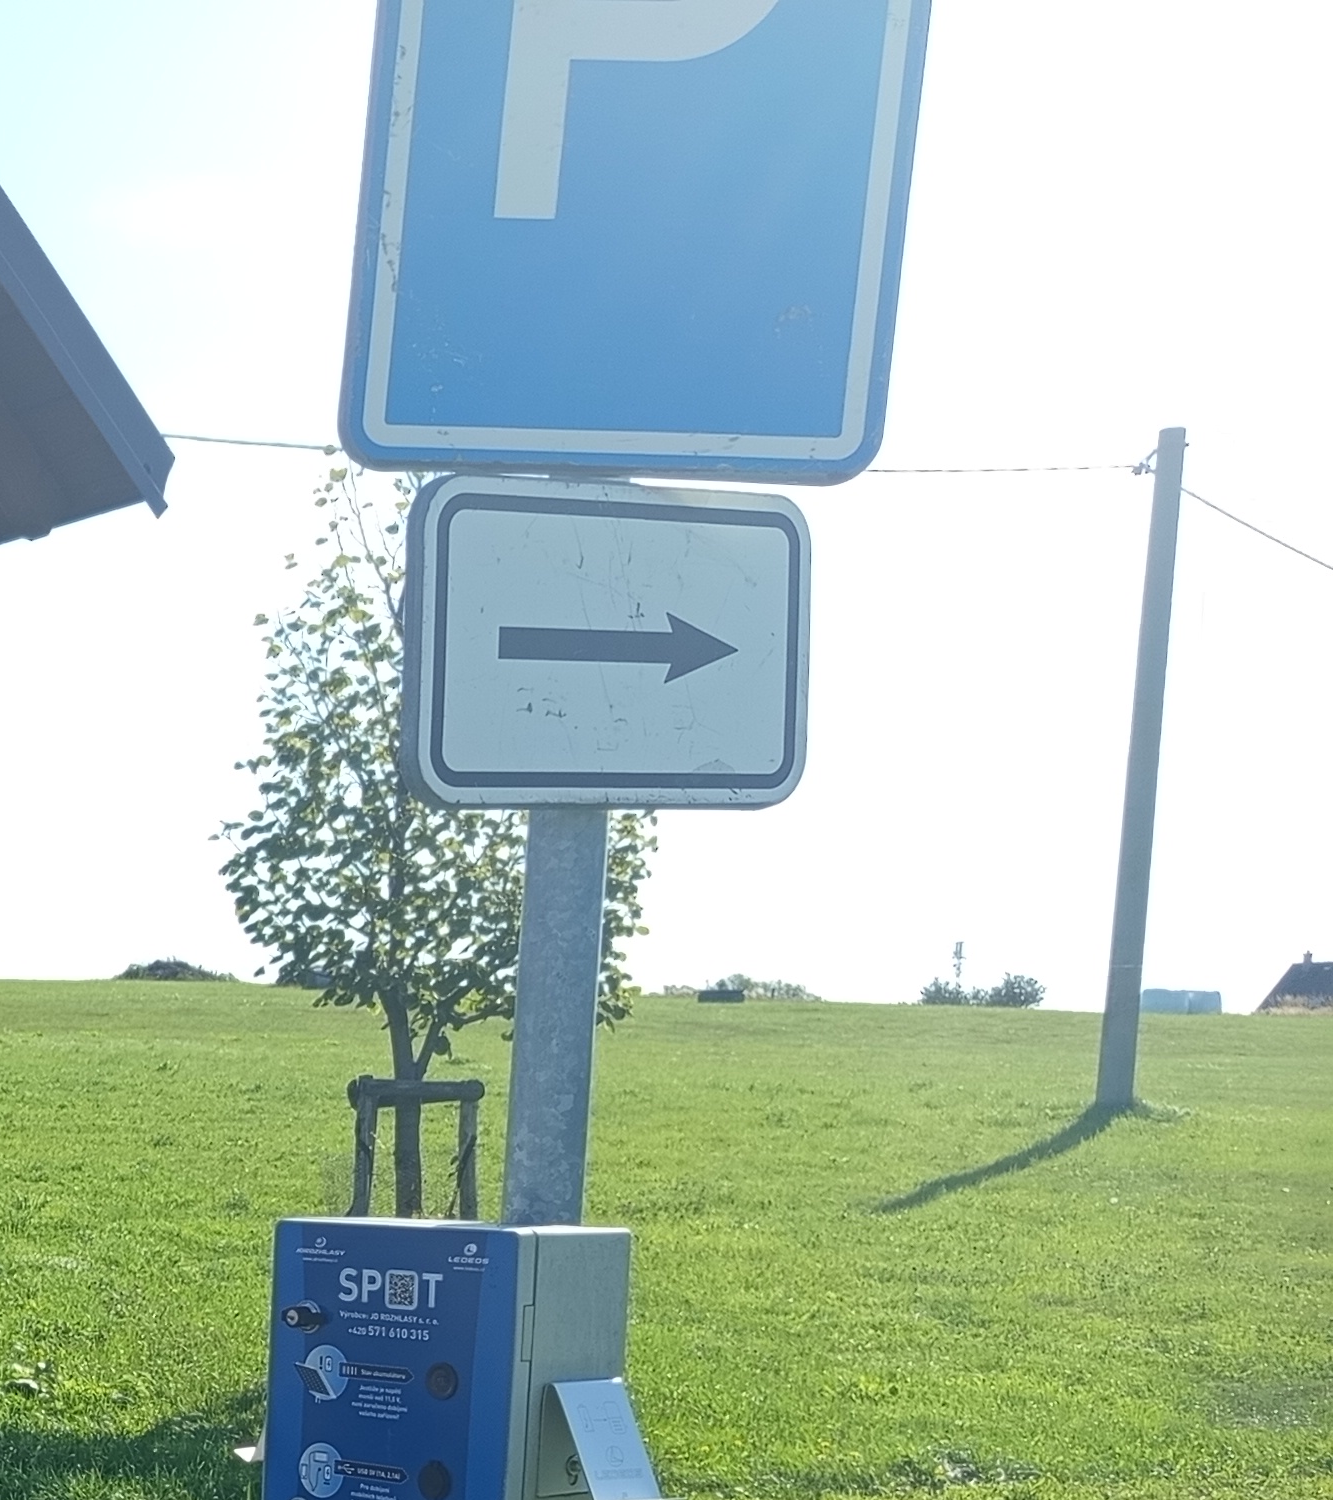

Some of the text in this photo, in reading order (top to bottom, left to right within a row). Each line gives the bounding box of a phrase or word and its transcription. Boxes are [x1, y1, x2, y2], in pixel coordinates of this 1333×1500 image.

[448, 1256, 489, 1265] LEDEOS
[368, 1325, 385, 1336] 571
[388, 1327, 408, 1339] 610
[409, 1329, 429, 1341] 315
